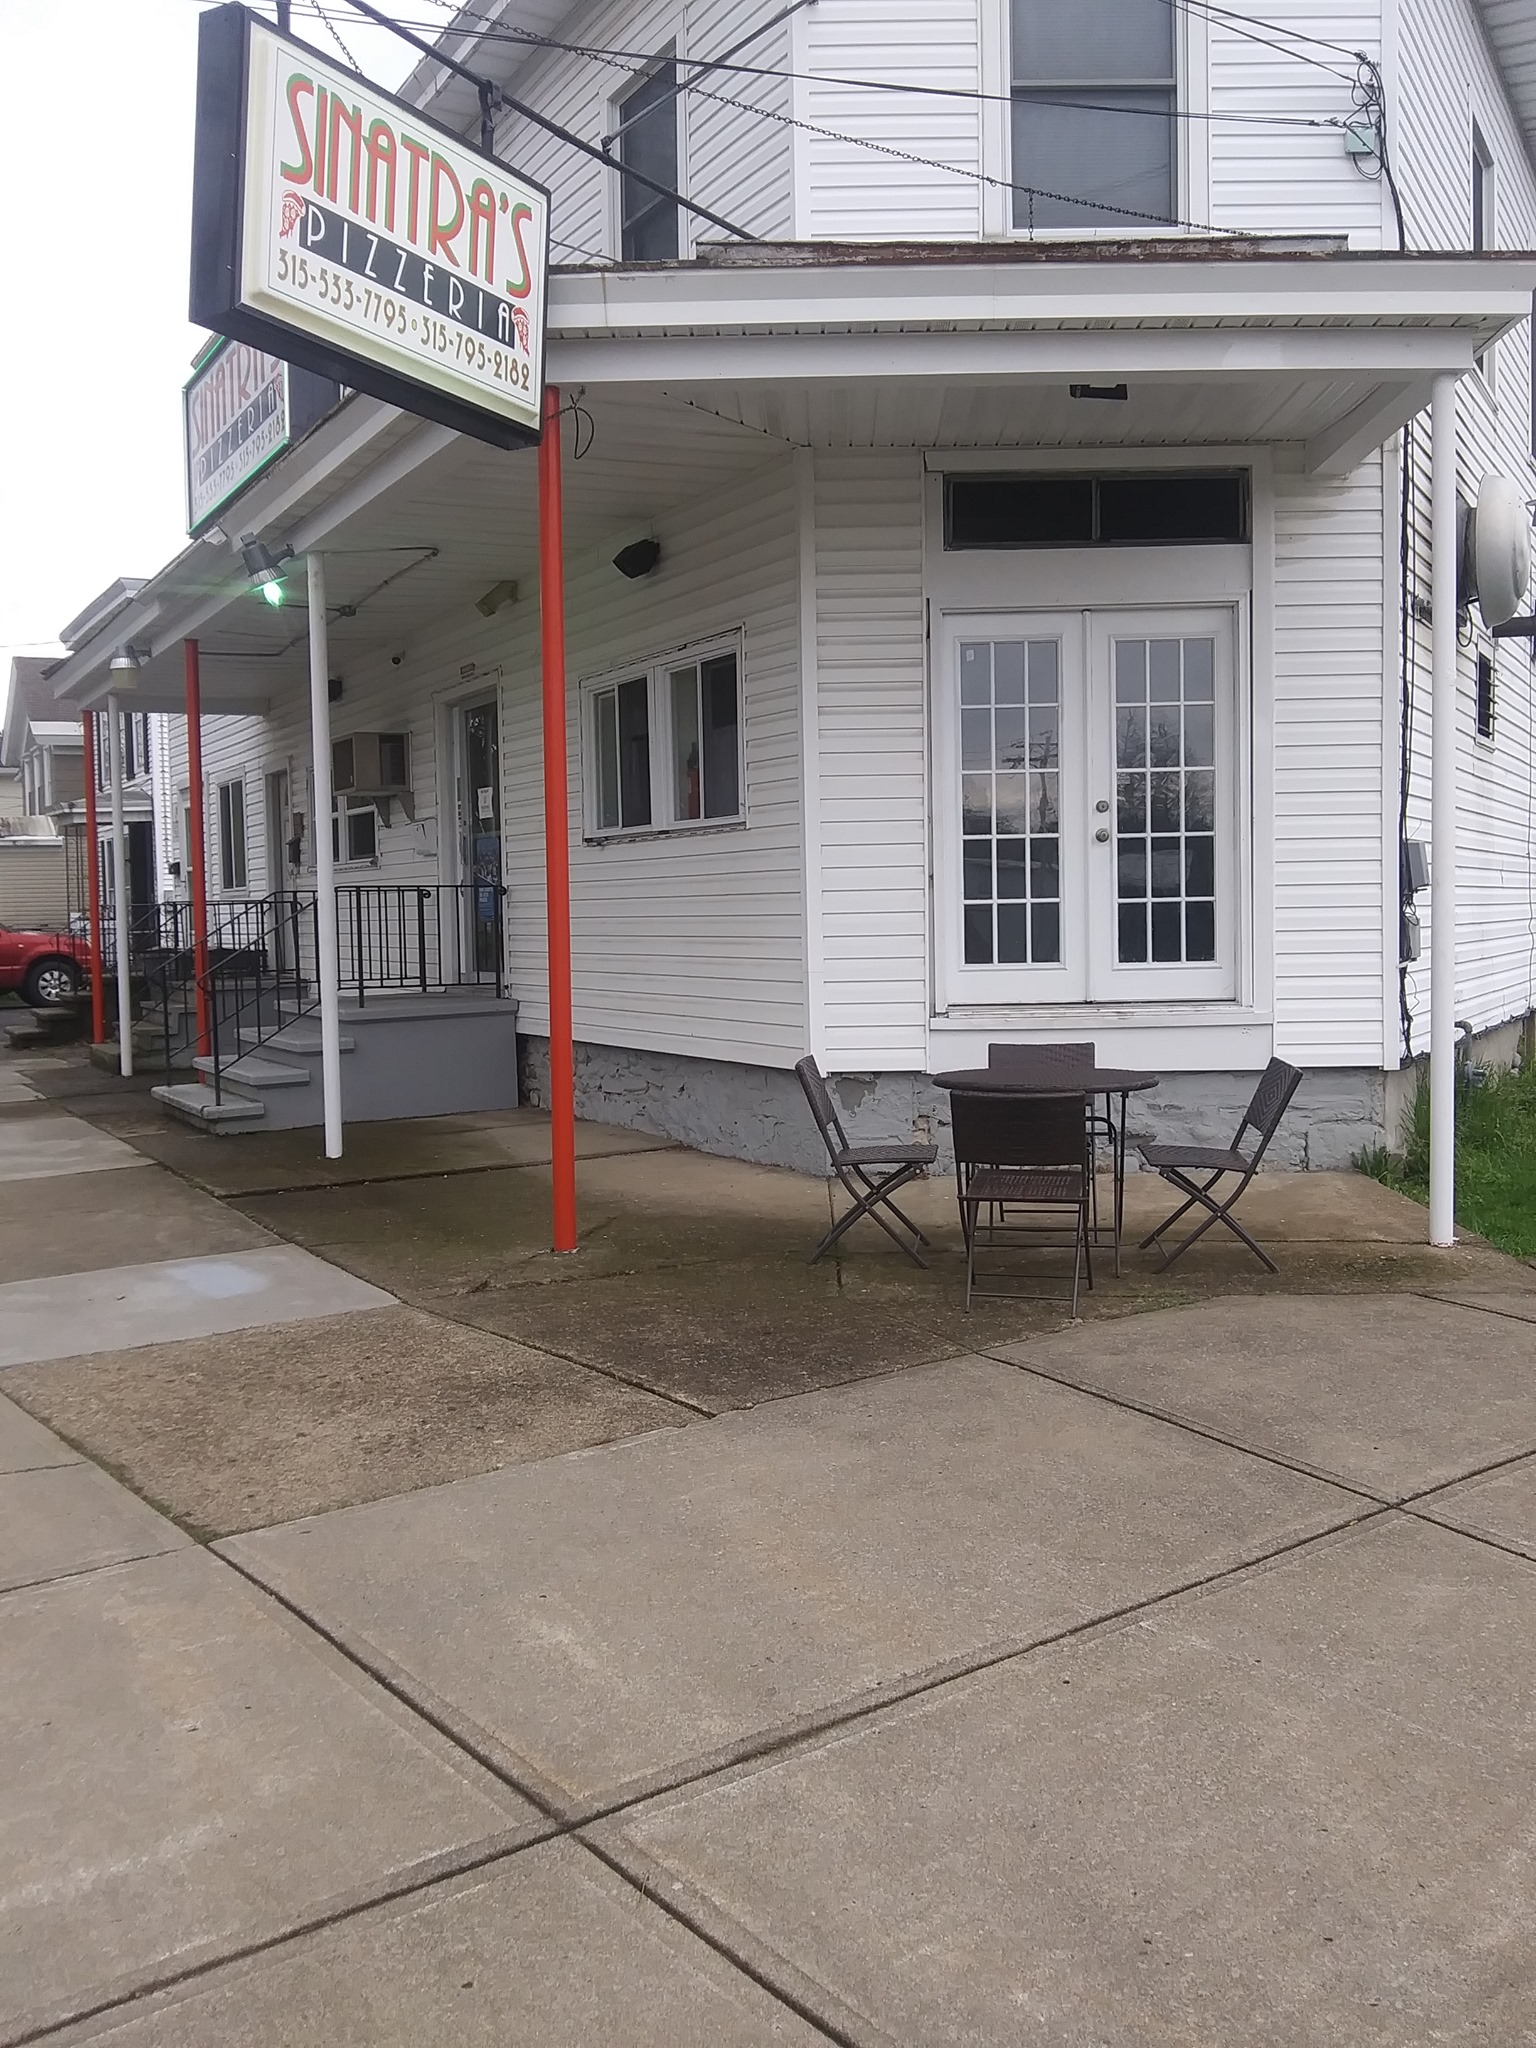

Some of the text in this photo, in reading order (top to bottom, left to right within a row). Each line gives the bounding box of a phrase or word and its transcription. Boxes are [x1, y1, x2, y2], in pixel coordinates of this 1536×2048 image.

[280, 73, 533, 299] SINATRA'S
[277, 247, 531, 392] 315-533-7795 315-795-2182
[307, 208, 511, 342] PIZZERIA
[199, 382, 275, 485] PIZZERIA
